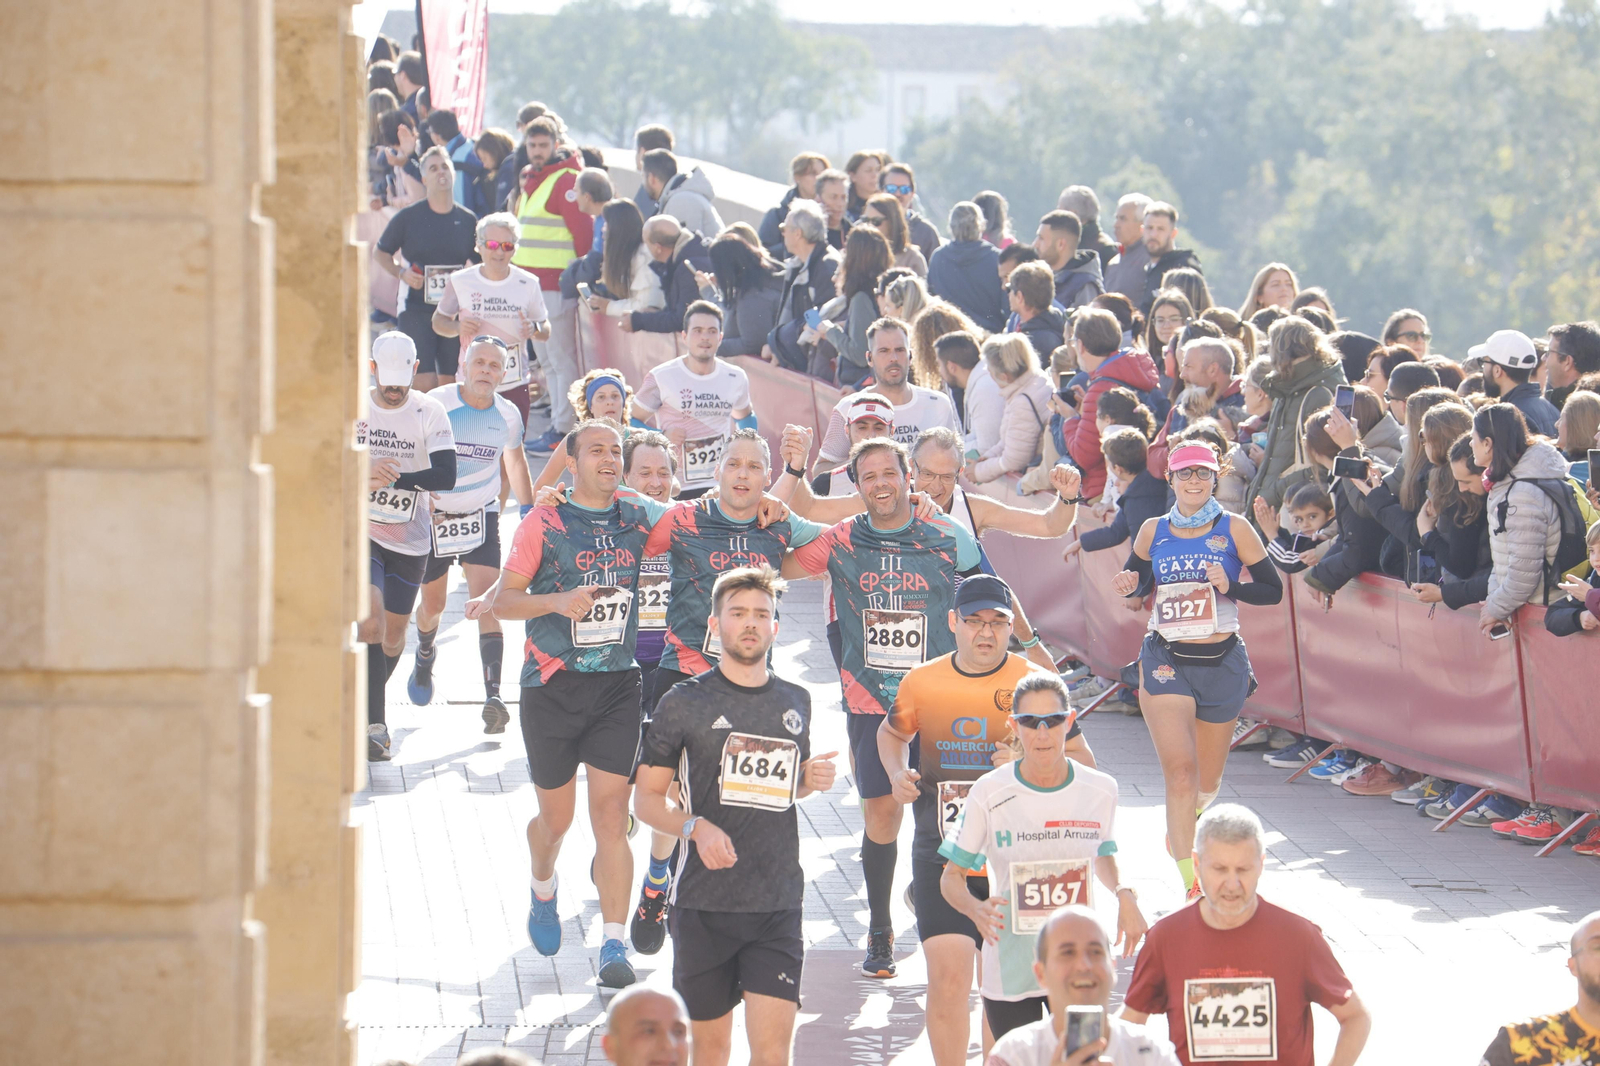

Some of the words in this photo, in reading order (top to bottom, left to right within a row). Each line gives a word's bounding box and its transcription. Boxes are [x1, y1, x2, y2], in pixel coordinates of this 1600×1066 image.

[694, 393, 720, 401] MEDIA
[680, 401, 692, 410] 37
[694, 410, 721, 418] CÓRDOBA
[369, 429, 398, 439] MEDIA
[369, 438, 416, 450] MARATÓN
[369, 449, 399, 458] CÓRDOBA
[474, 447, 497, 458] CLEAN
[437, 521, 481, 539] 2858
[575, 548, 636, 571] EPORA
[1159, 556, 1176, 564] CLUB
[1180, 553, 1224, 562] ATLETISMO
[859, 571, 930, 593] EPORA
[580, 602, 628, 623] 2879
[1161, 599, 1207, 620] 5127
[867, 627, 921, 648] 2880
[936, 740, 998, 752] COMERCIA
[940, 752, 993, 766] ARROY
[730, 755, 788, 781] 1684
[945, 802, 963, 823] 2
[1016, 830, 1060, 842] Hospital
[1024, 881, 1082, 907] 5167
[1193, 1004, 1268, 1028] 4425
